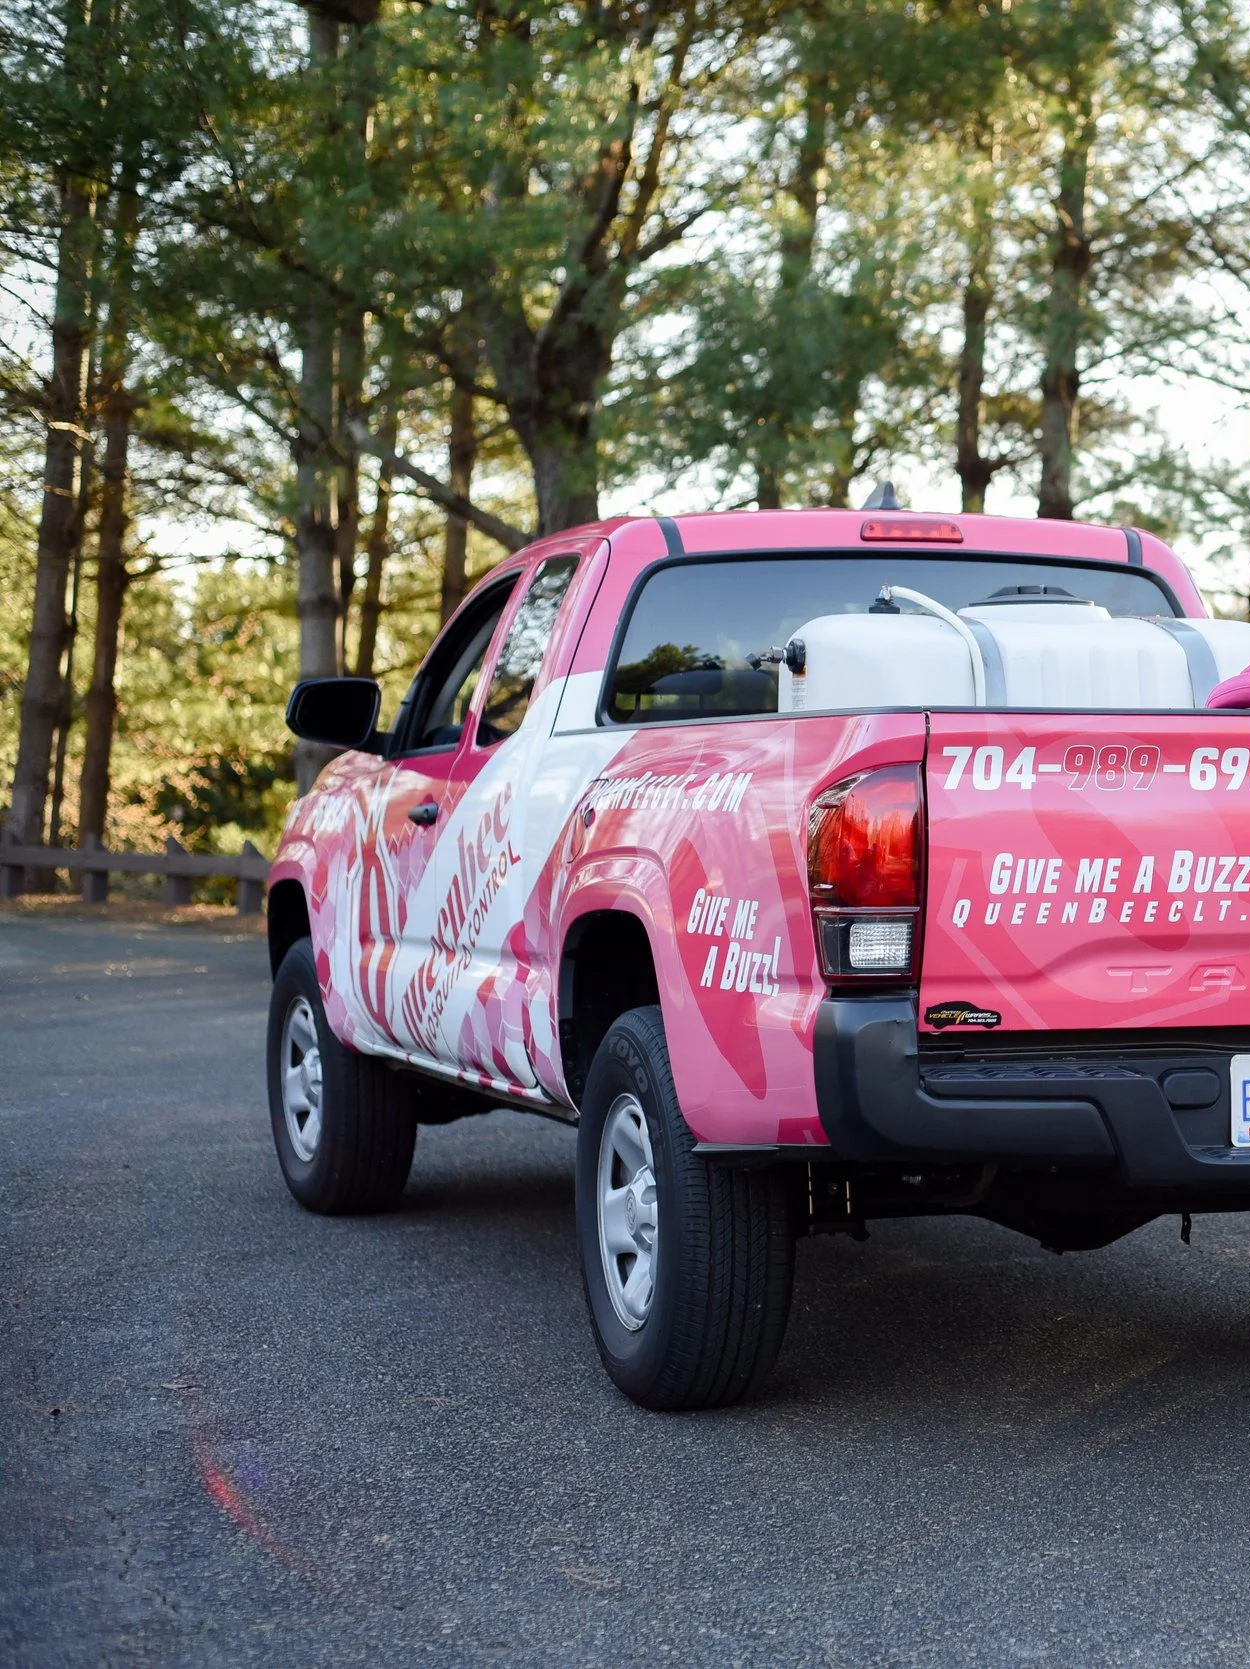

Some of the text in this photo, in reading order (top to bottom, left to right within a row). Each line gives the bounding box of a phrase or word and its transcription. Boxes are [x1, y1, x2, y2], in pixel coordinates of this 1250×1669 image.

[468, 840, 522, 949] CONTROL
[989, 852, 1064, 896] GIVE
[1132, 855, 1155, 894] A
[686, 886, 730, 937] GIVE
[700, 946, 719, 988] A
[608, 1036, 649, 1094] TOYO
